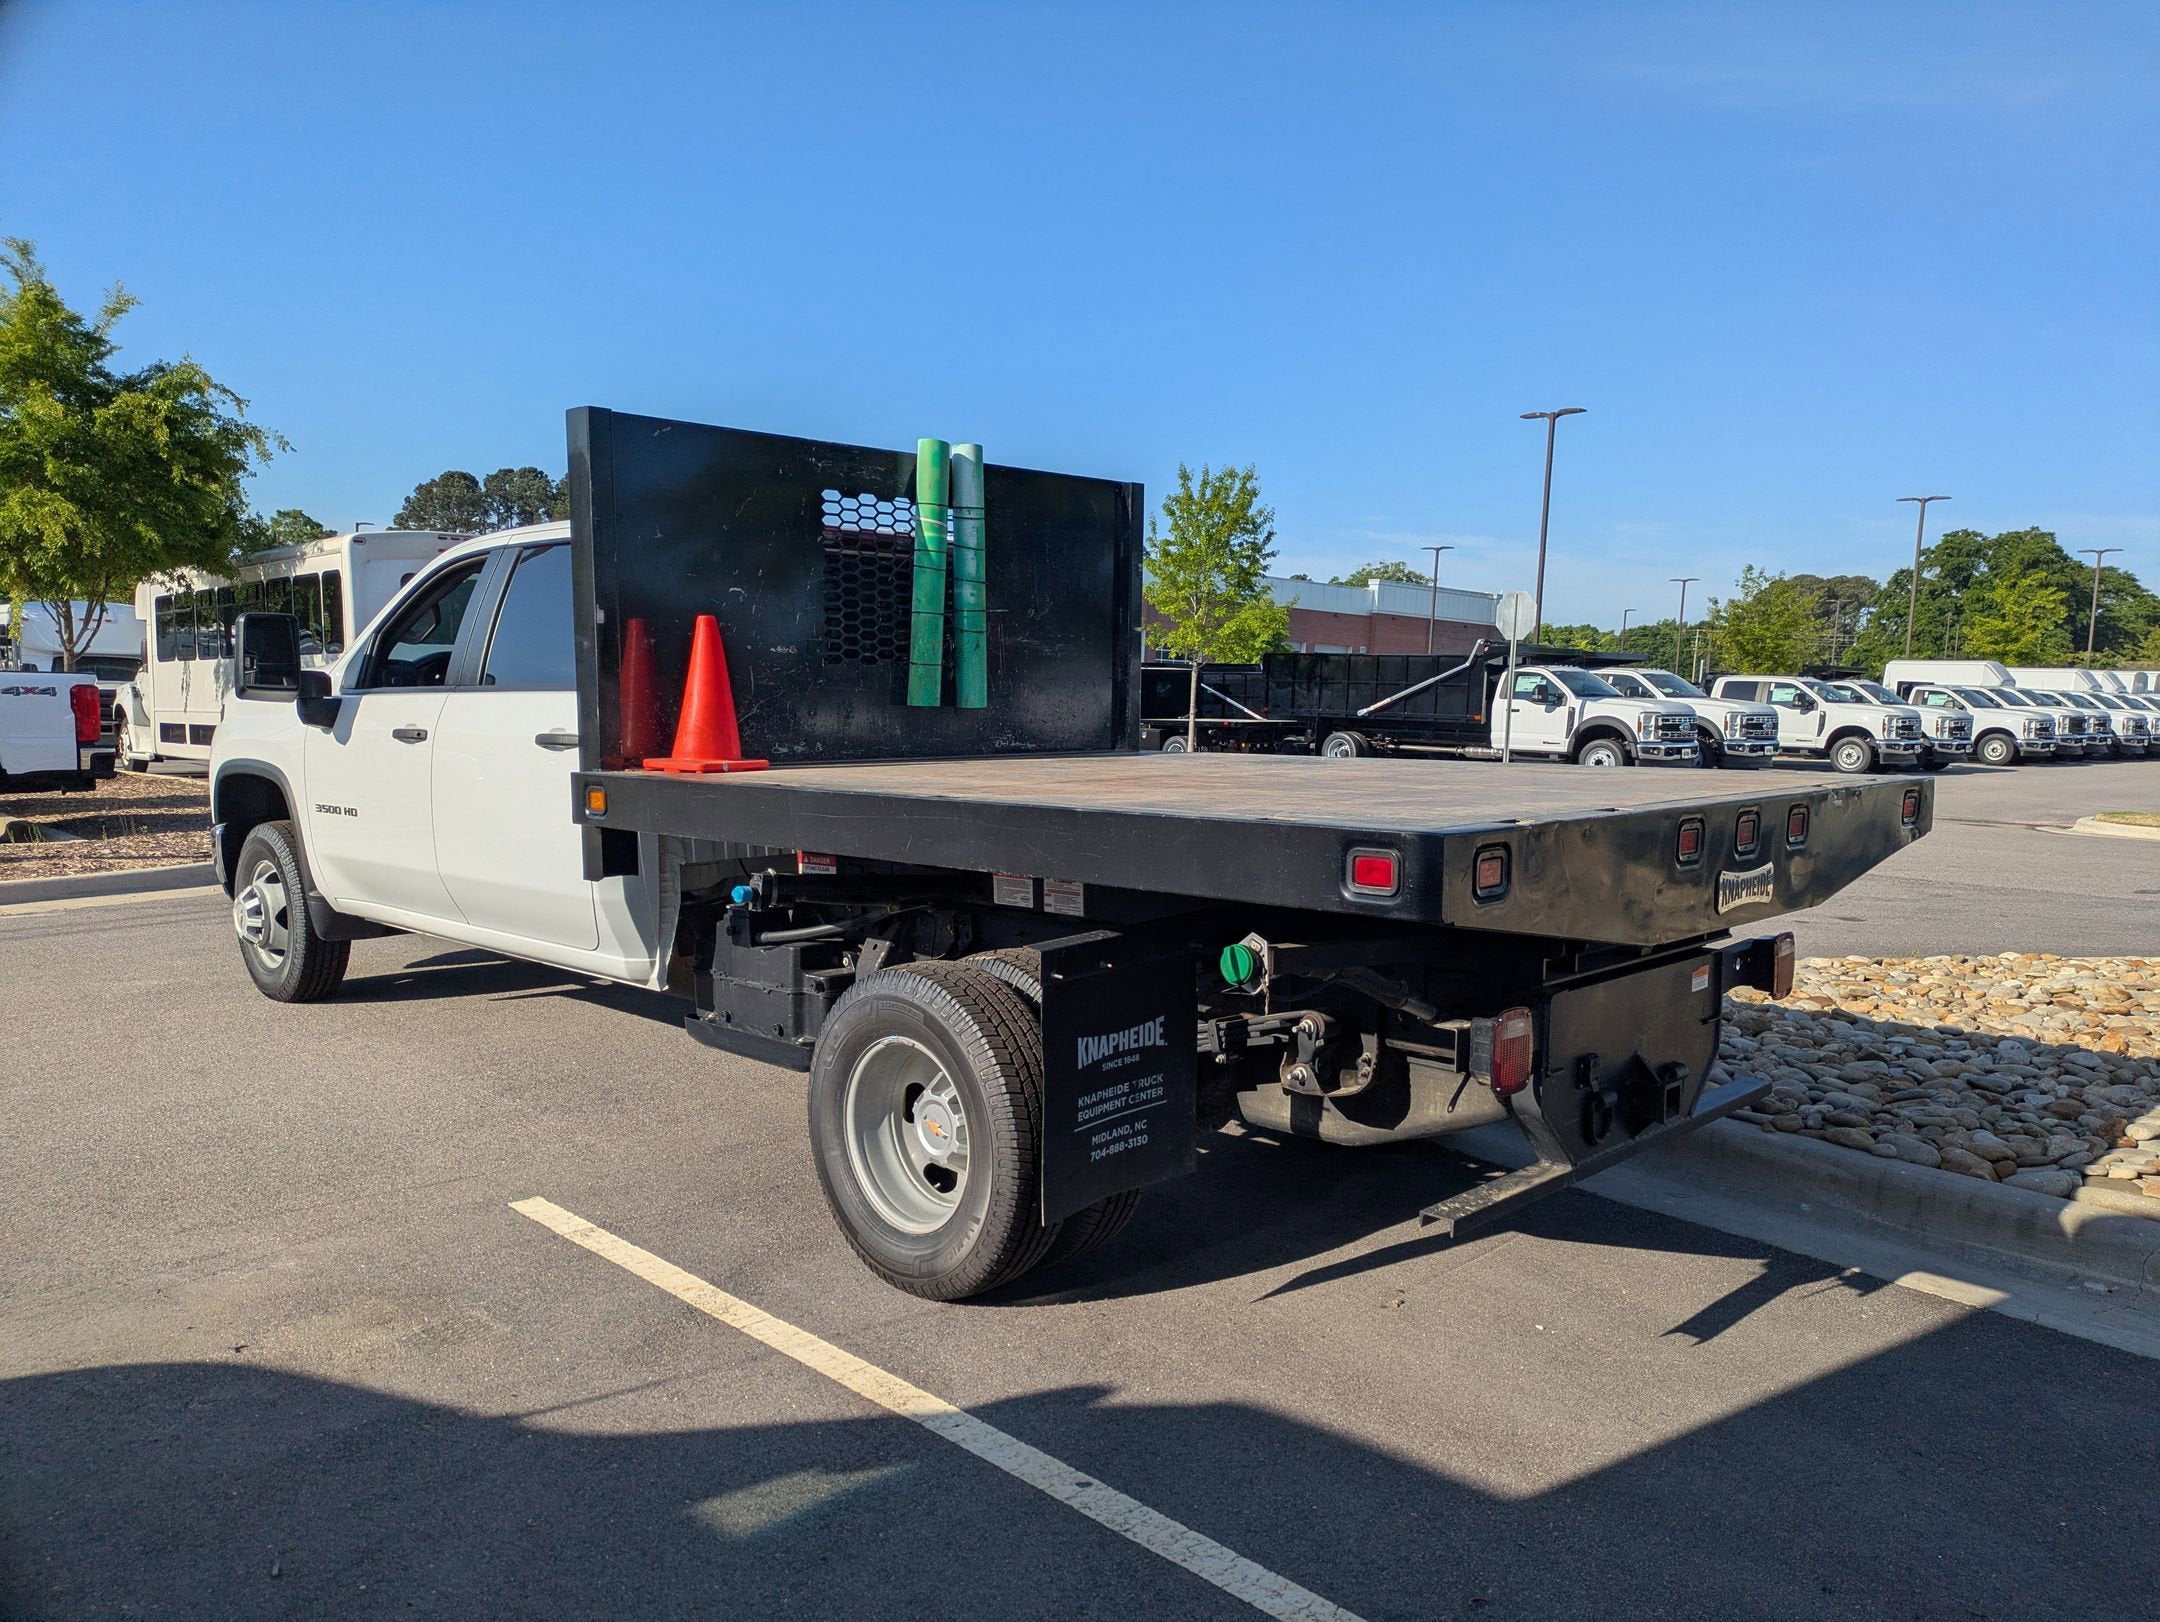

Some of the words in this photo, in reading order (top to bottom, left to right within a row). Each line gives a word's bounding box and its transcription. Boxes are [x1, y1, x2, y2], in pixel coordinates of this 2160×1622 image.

[315, 803, 342, 815] 3500
[343, 806, 358, 817] HD
[1720, 868, 1773, 908] KNAPHEIDE
[1102, 1058, 1123, 1071] SINCE
[1124, 1053, 1140, 1065] 1848
[1077, 1096, 1127, 1122] EQUIPMENT
[1128, 1086, 1164, 1104] CENTER
[1078, 1082, 1130, 1108] KNAPHEIDE
[1091, 1124, 1133, 1146] MIDLAND,
[1134, 1119, 1148, 1132] NC
[1090, 1134, 1149, 1162] 704-888-3130
